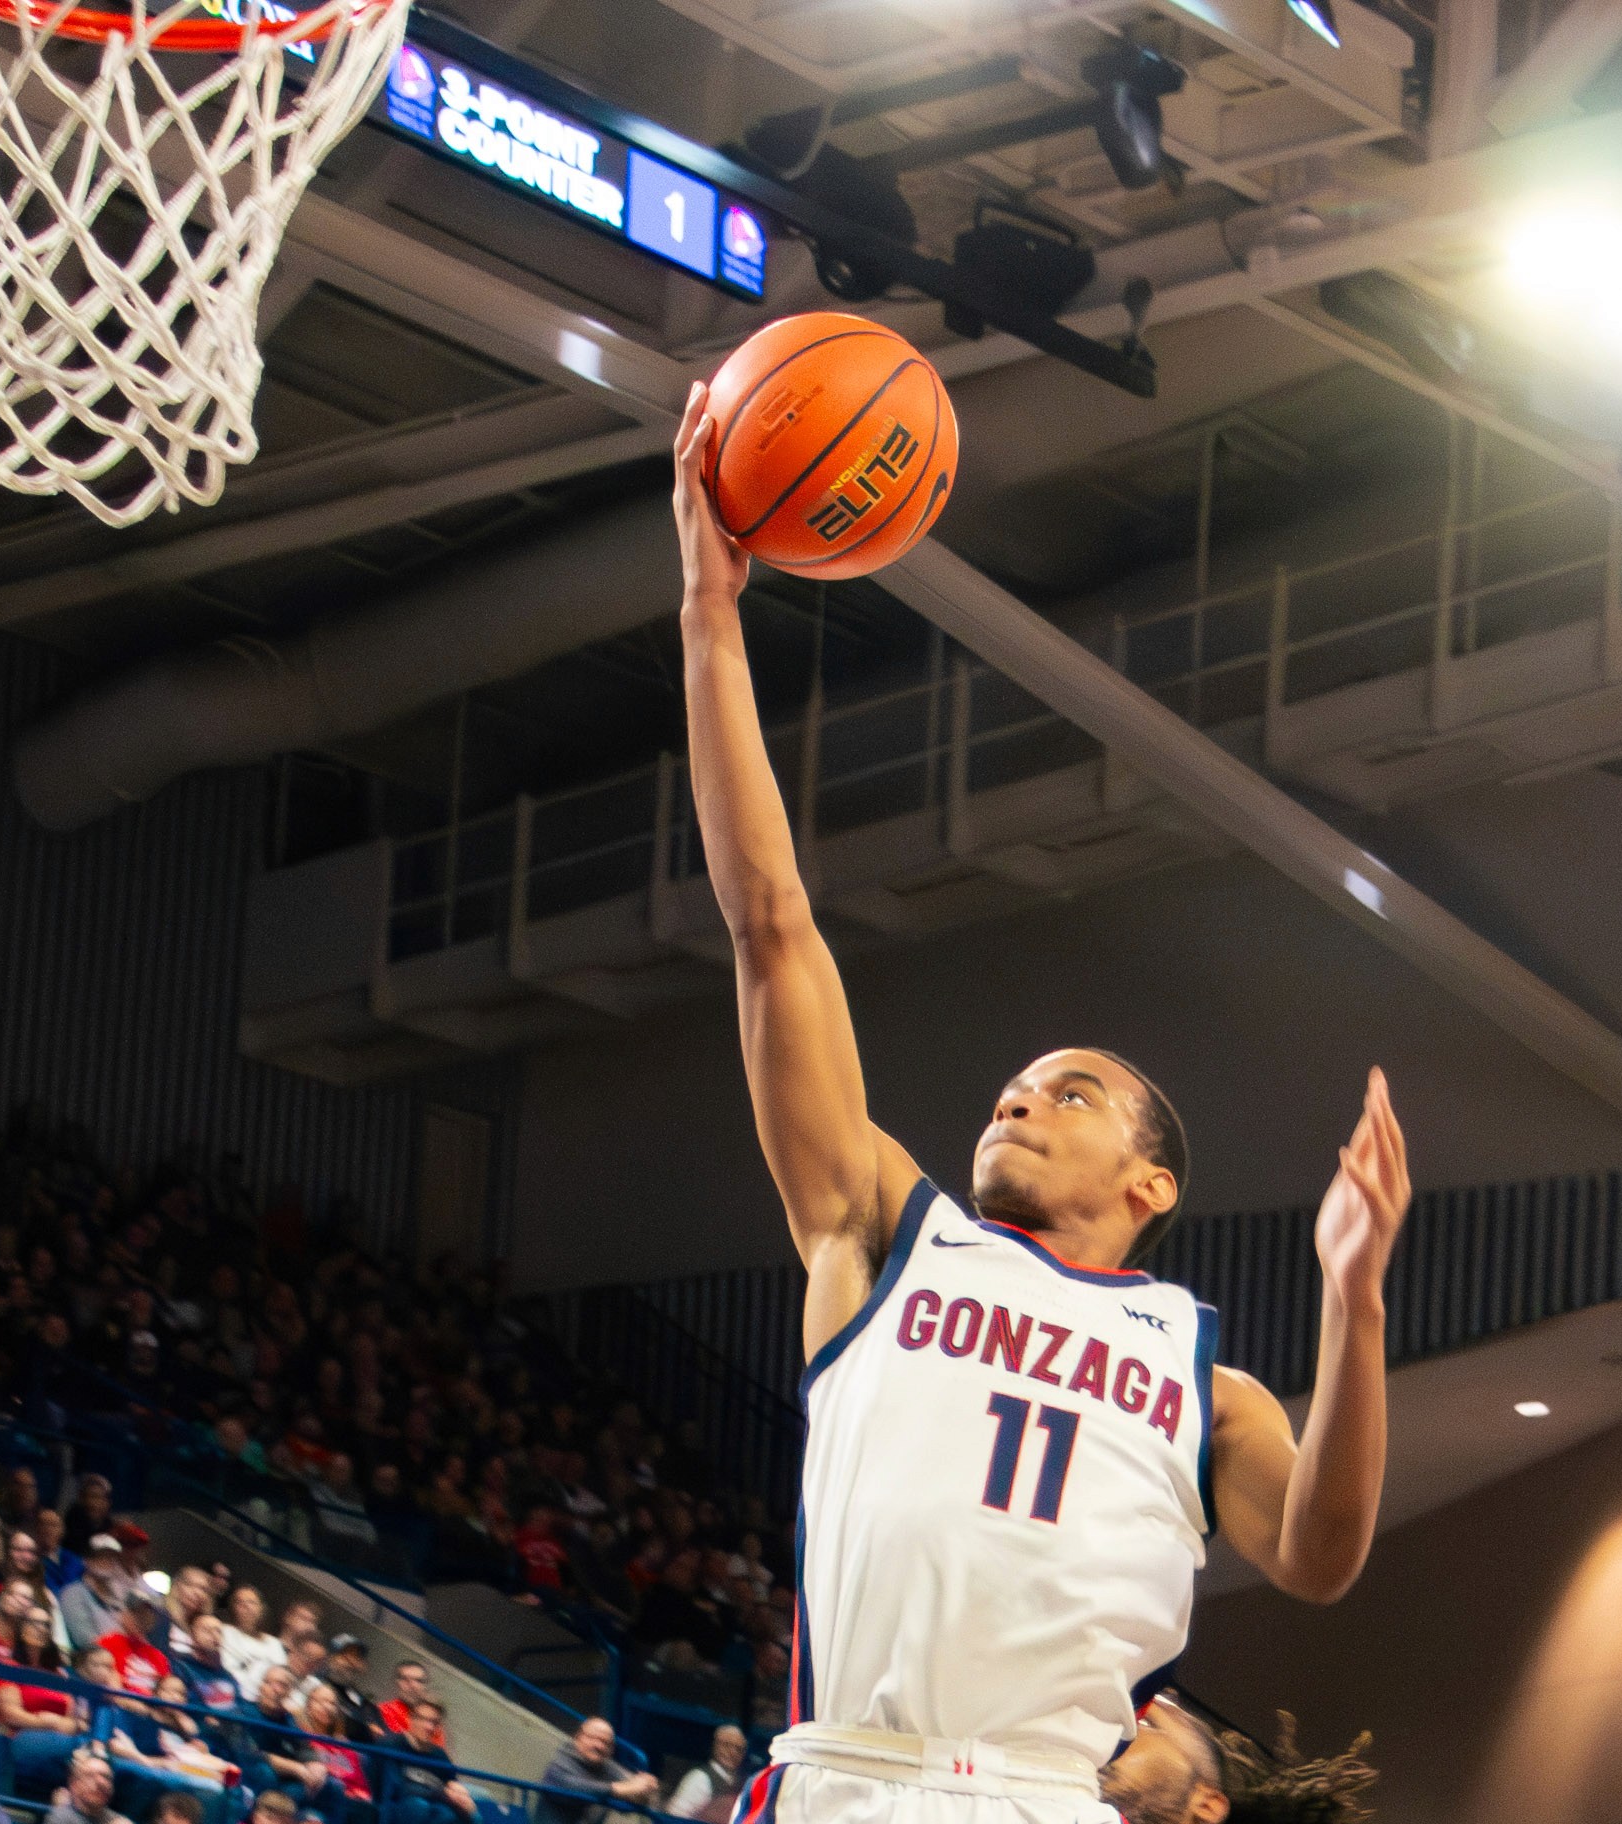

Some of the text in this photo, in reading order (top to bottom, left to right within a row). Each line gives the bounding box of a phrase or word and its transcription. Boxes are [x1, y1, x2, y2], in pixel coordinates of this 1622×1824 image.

[437, 106, 625, 228] COUNTER
[439, 67, 601, 175] 3-POINT
[663, 191, 685, 243] 1
[806, 421, 920, 543] ELITE
[896, 1289, 1184, 1445] GONZAGA
[981, 1391, 1081, 1526] 11
